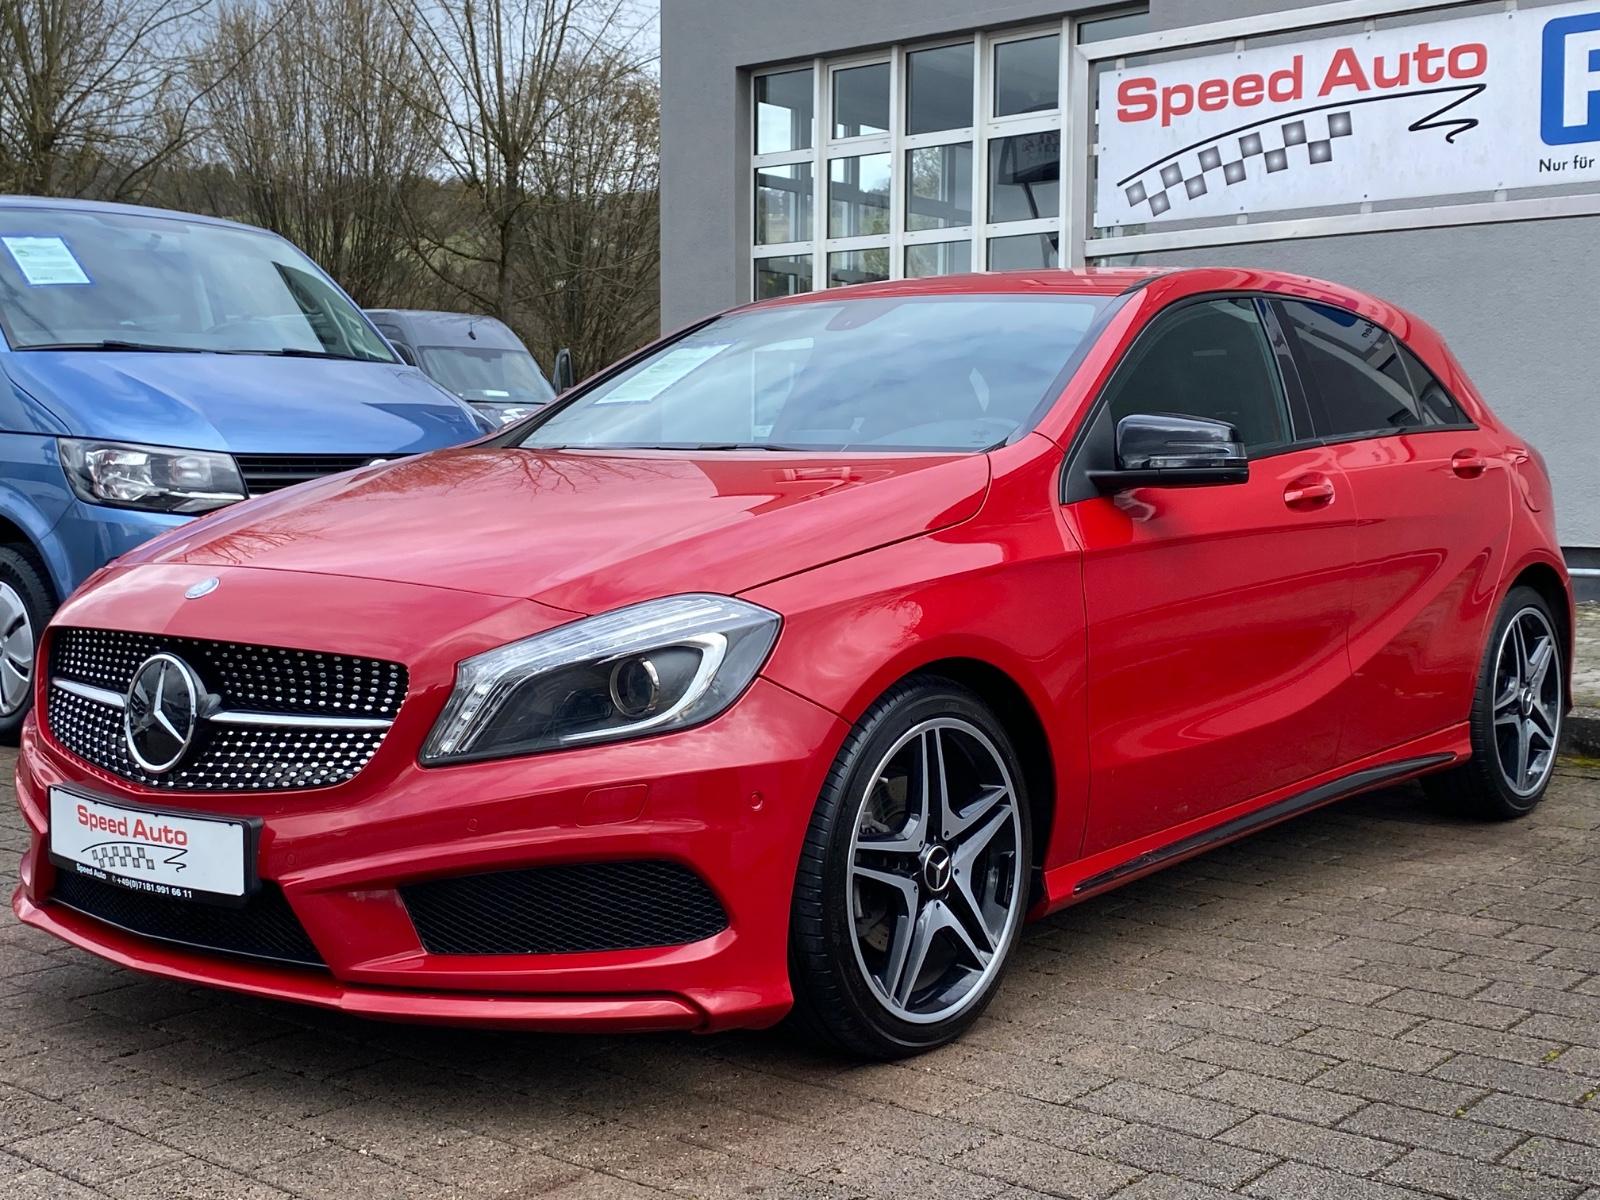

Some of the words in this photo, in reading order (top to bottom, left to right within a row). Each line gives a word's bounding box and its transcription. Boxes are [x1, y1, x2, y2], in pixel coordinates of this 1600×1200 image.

[1116, 55, 1304, 127] Speed
[1317, 42, 1488, 97] Auto
[1538, 158, 1568, 173] Nur
[1573, 154, 1596, 170] für
[76, 804, 129, 837] Speed
[132, 818, 188, 846] Auto
[76, 862, 93, 876] Speed
[93, 868, 107, 880] Auto
[171, 887, 182, 897] 66
[183, 889, 193, 899] 11
